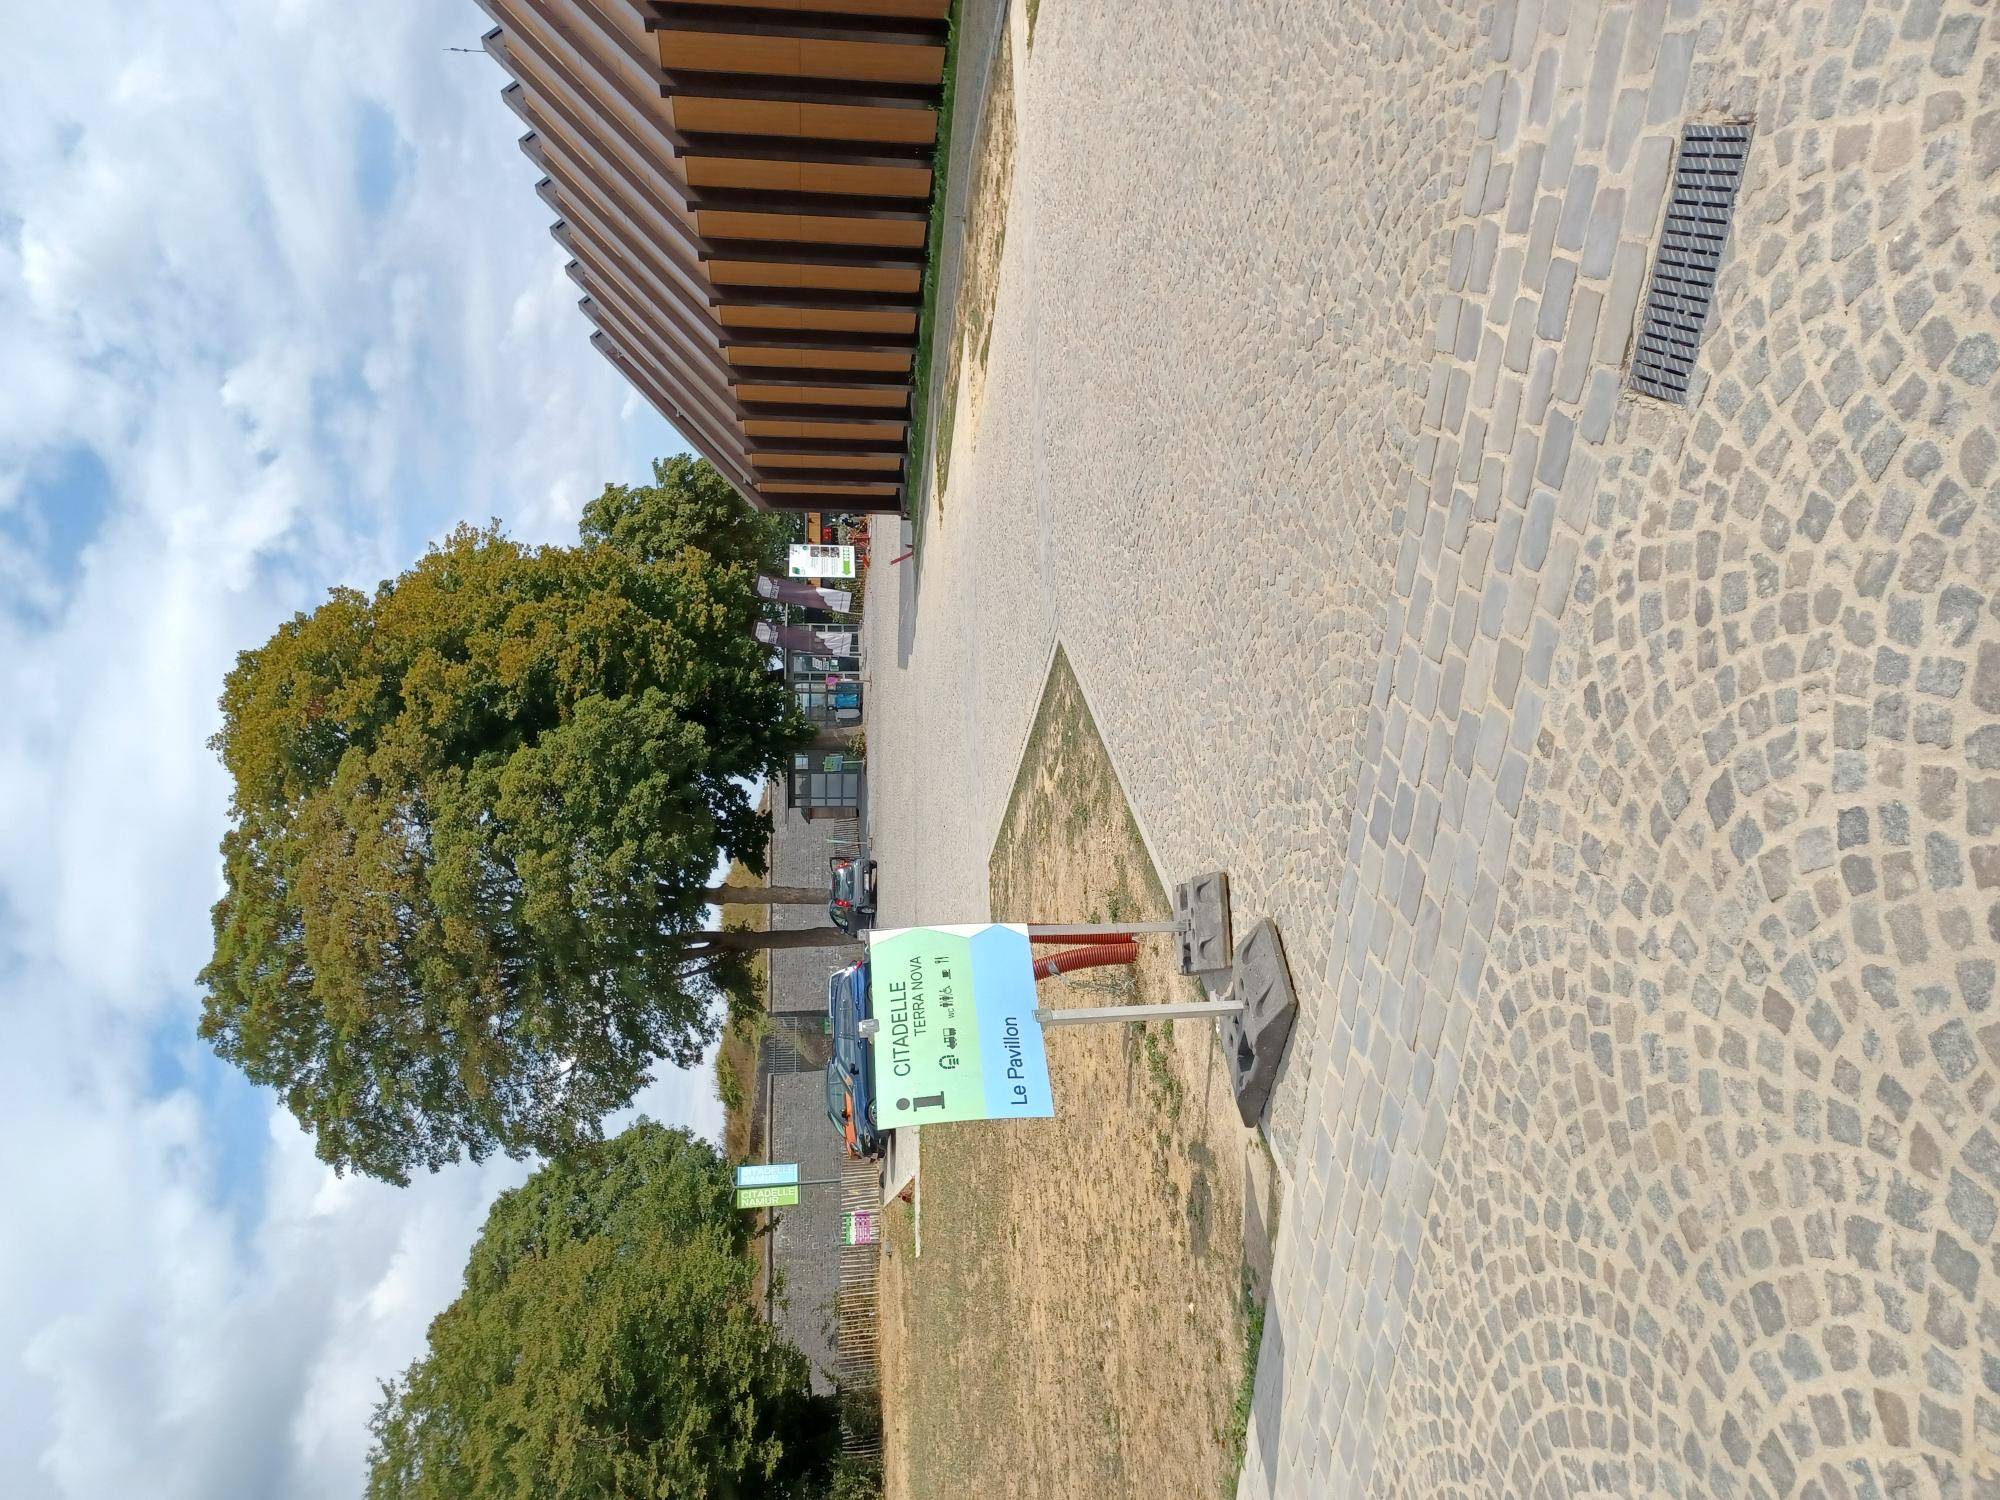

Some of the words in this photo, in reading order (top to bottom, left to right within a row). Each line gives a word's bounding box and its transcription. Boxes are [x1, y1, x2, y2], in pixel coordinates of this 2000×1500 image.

[910, 956, 924, 990] NOVA
[890, 981, 911, 1077] CITADELLE
[911, 993, 927, 1037] TERRA
[1003, 1017, 1025, 1079] Pavillon
[1011, 1085, 1027, 1105] Le
[741, 1187, 795, 1199] CITADELLE
[742, 1196, 779, 1207] NAMUR
